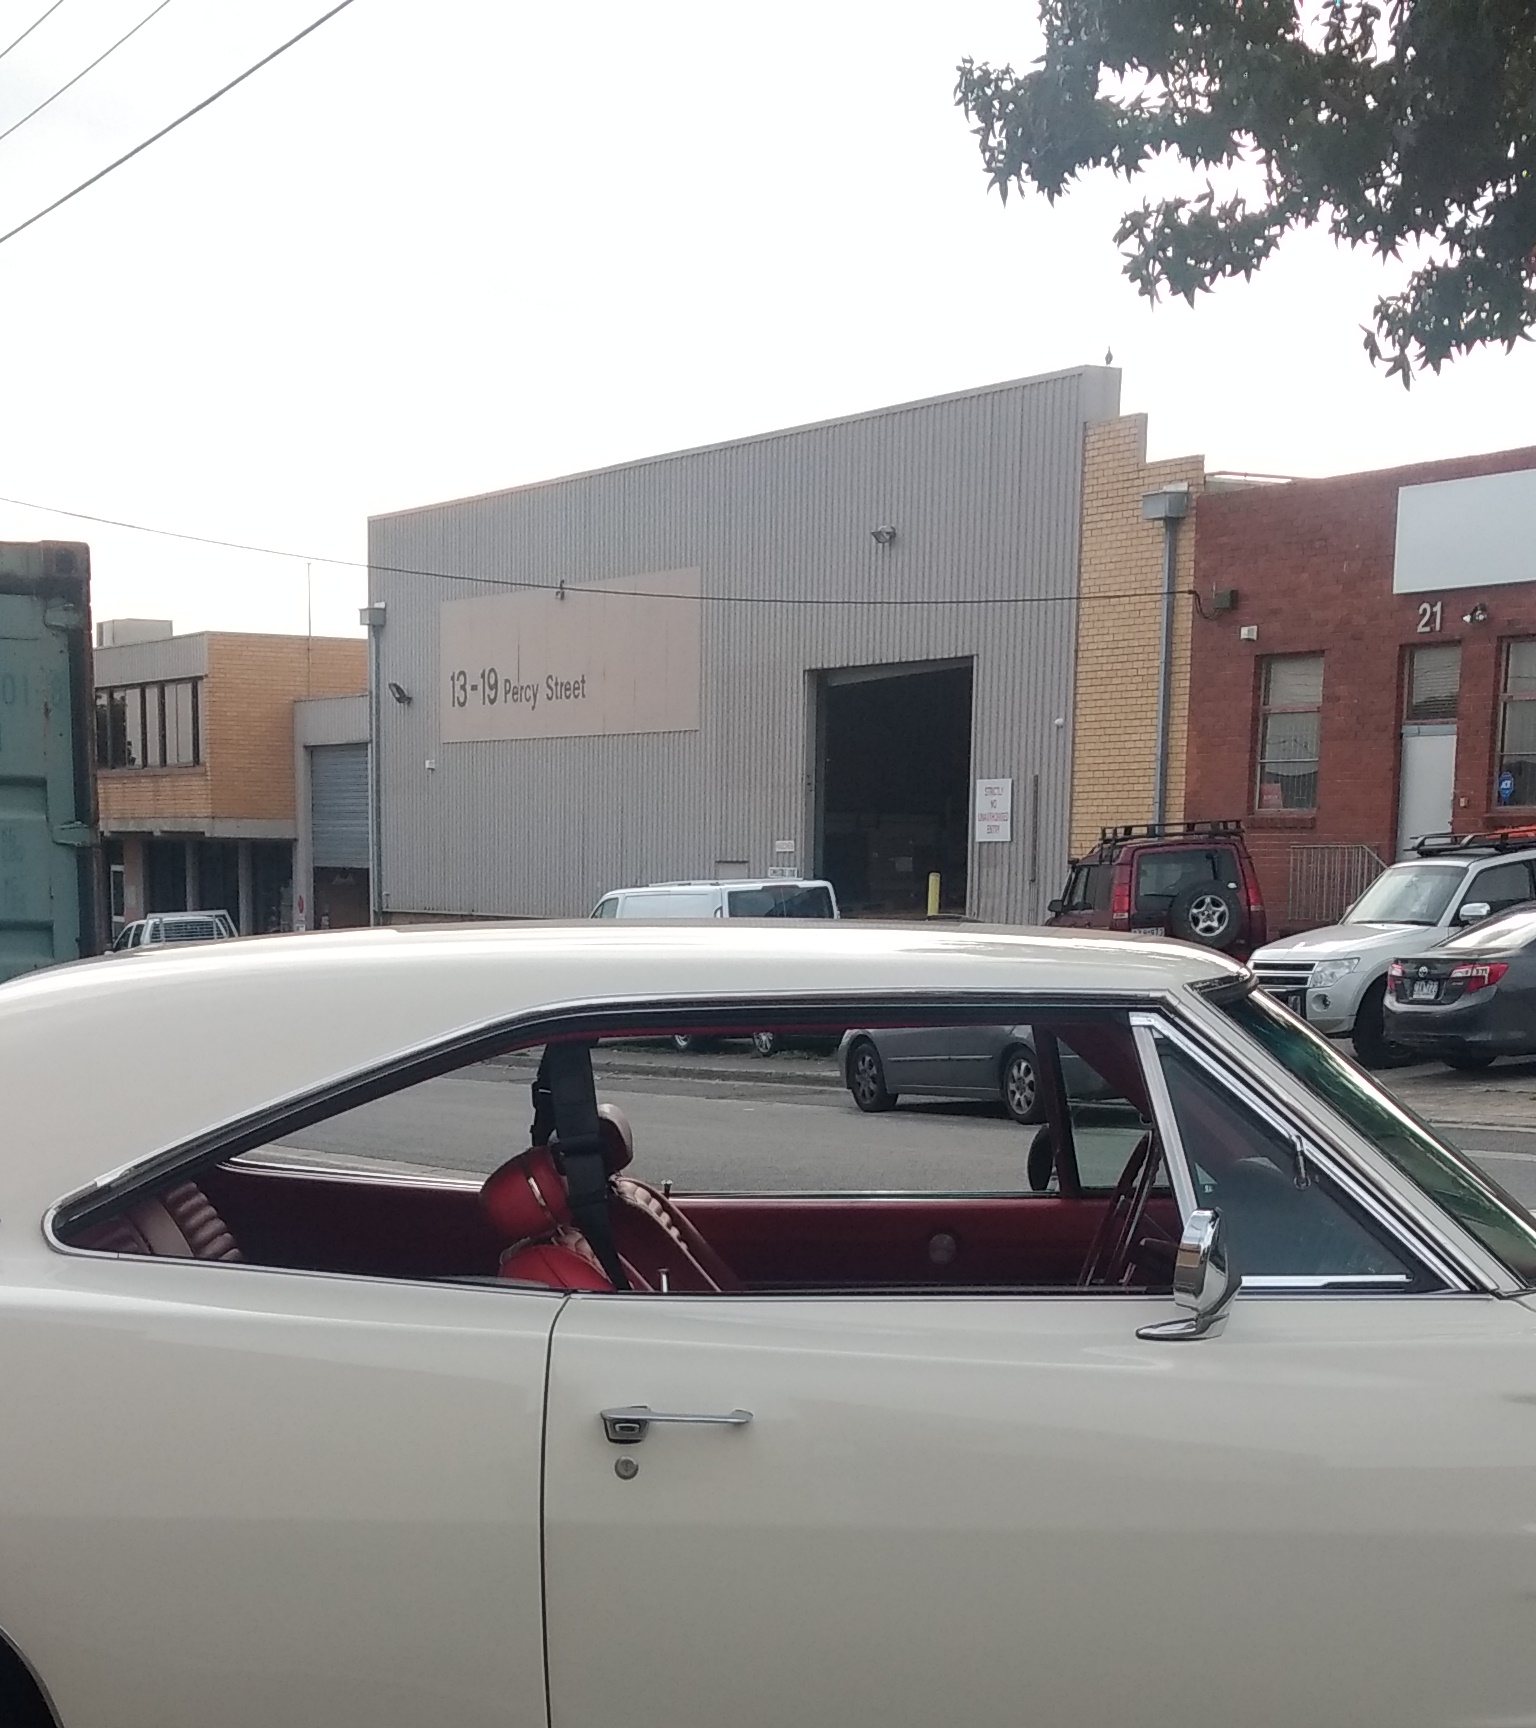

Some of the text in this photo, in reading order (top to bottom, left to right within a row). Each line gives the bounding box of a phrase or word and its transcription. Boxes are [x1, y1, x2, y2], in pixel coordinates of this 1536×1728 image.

[1416, 600, 1443, 633] 21
[450, 667, 586, 711] 13-19 Percy Street
